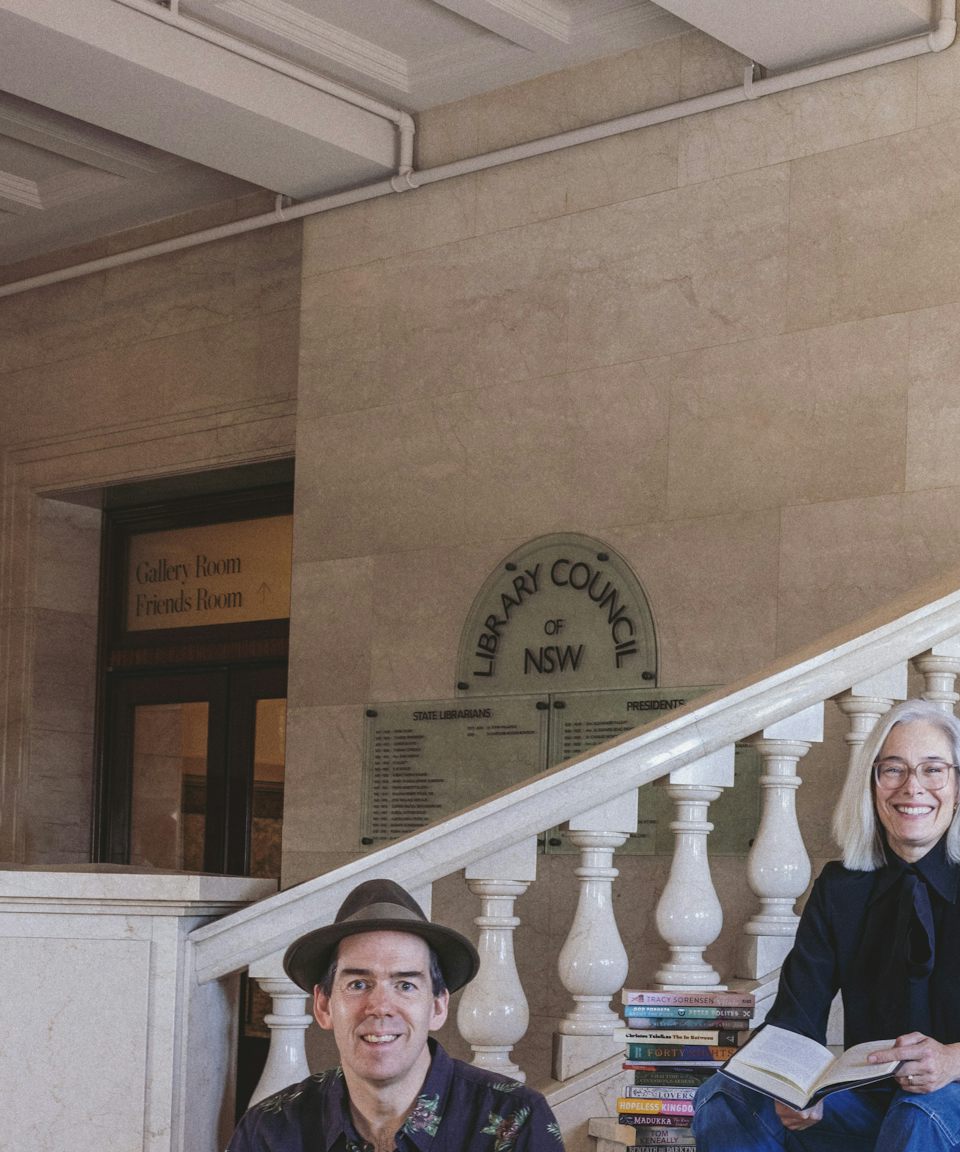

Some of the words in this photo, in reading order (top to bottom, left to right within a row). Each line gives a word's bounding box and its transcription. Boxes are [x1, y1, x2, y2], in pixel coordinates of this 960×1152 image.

[136, 559, 189, 584] Gallery
[195, 554, 242, 578] Room
[136, 590, 192, 616] Friends
[197, 588, 243, 611] Room
[473, 563, 540, 677] LIBRARY
[551, 559, 638, 669] COUNCIL
[544, 619, 565, 635] OF
[524, 644, 584, 674] NSW
[413, 710, 438, 721] STATE
[439, 708, 491, 720] LIBRARIANS
[673, 995, 714, 1004] SORENSEN
[647, 1047, 685, 1058] FORTY
[619, 1101, 659, 1111] HOPELESS
[633, 1116, 672, 1125] MADUKKA
